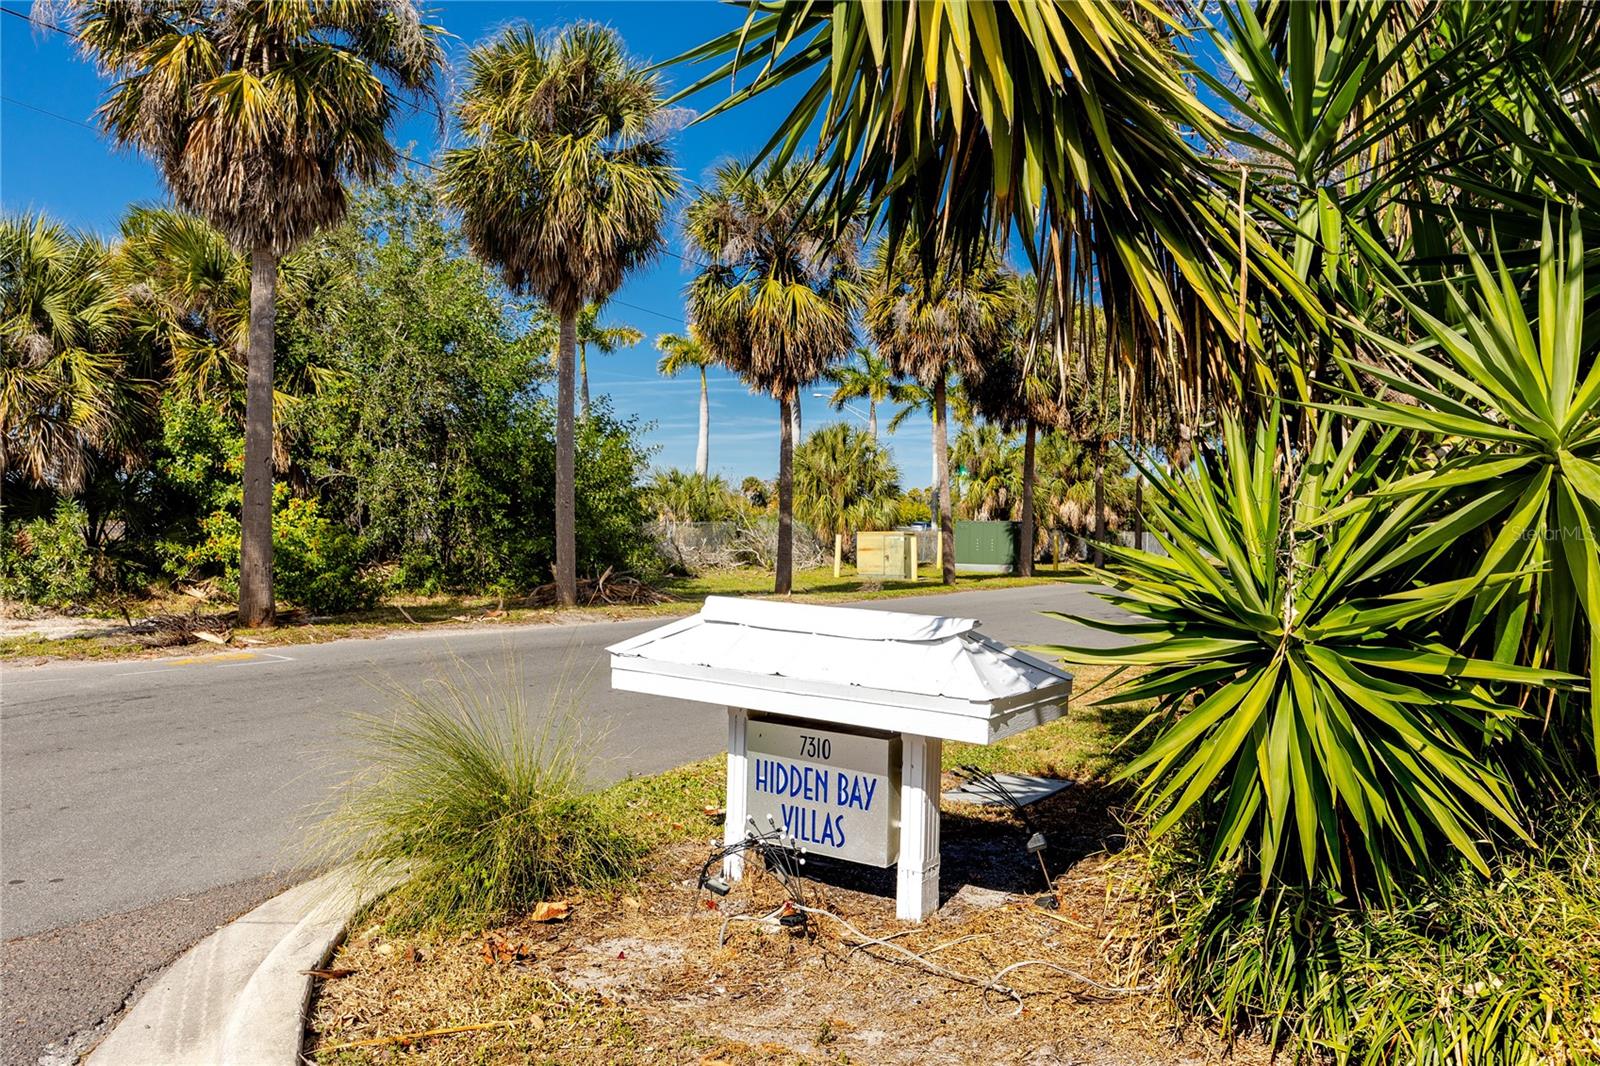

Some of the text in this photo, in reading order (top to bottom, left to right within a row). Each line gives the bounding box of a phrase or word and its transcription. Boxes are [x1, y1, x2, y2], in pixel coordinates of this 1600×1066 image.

[800, 735, 831, 760] 7310
[756, 758, 877, 811] HIDDEN BAY
[781, 803, 845, 848] VILLAS
